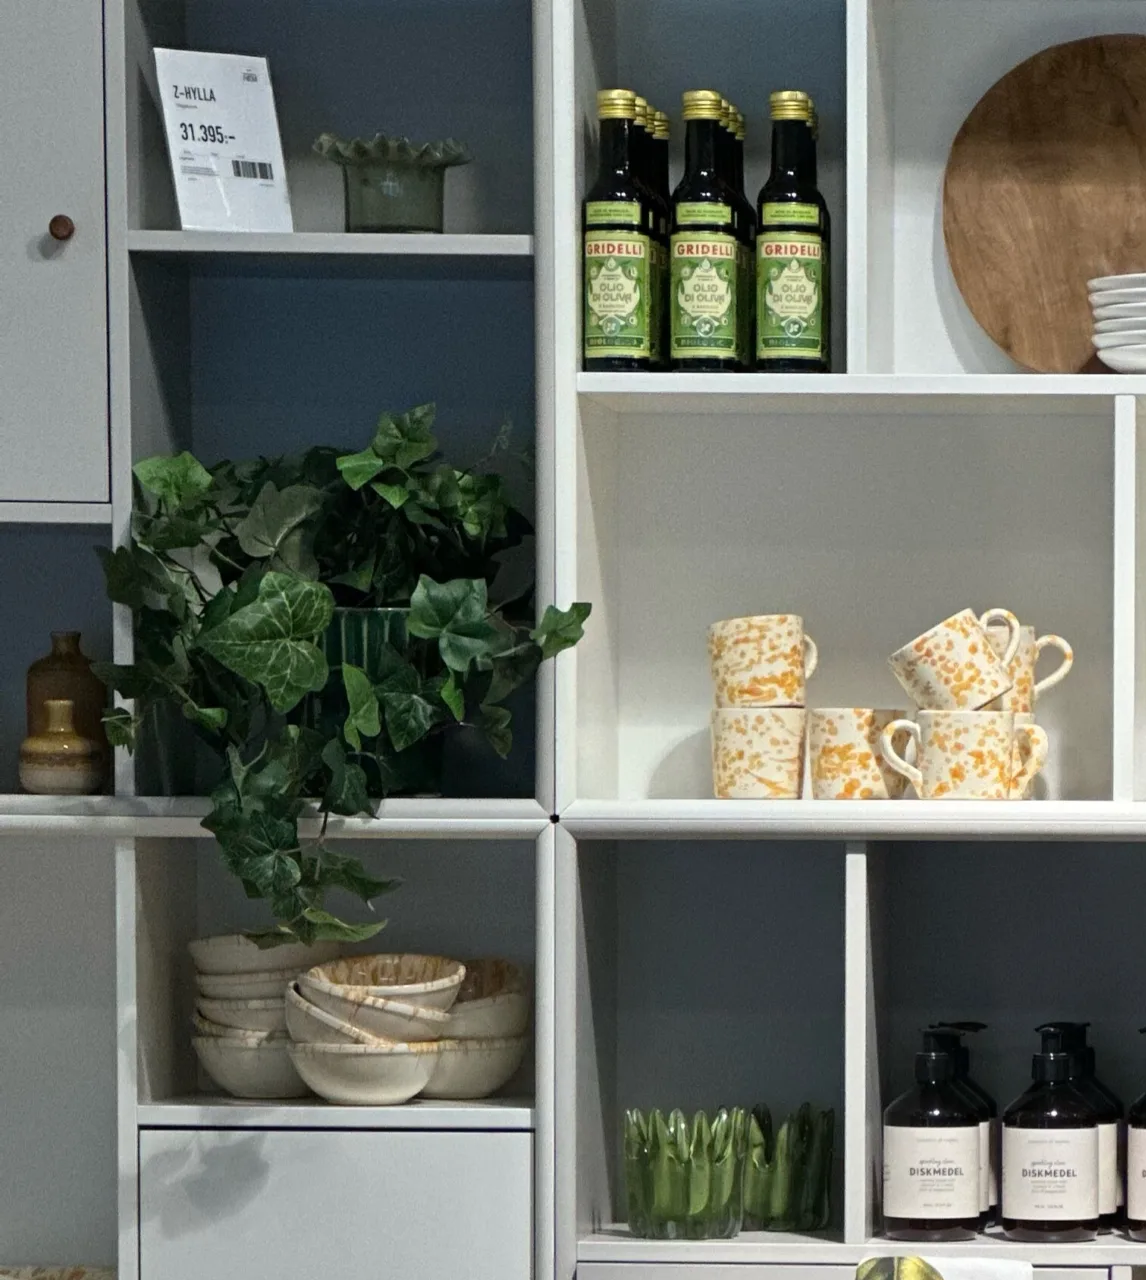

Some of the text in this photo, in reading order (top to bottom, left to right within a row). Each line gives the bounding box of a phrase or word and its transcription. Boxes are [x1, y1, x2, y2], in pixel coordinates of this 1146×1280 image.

[172, 84, 217, 102] Z-HYLLA
[179, 122, 236, 144] 31.395:-
[587, 243, 642, 256] GRIDELLI
[677, 243, 733, 256] GRIDELLI
[764, 244, 820, 257] GRIDELLI
[909, 1167, 965, 1176] DISKMEDEL
[1021, 1168, 1078, 1178] DISKMEDEL
